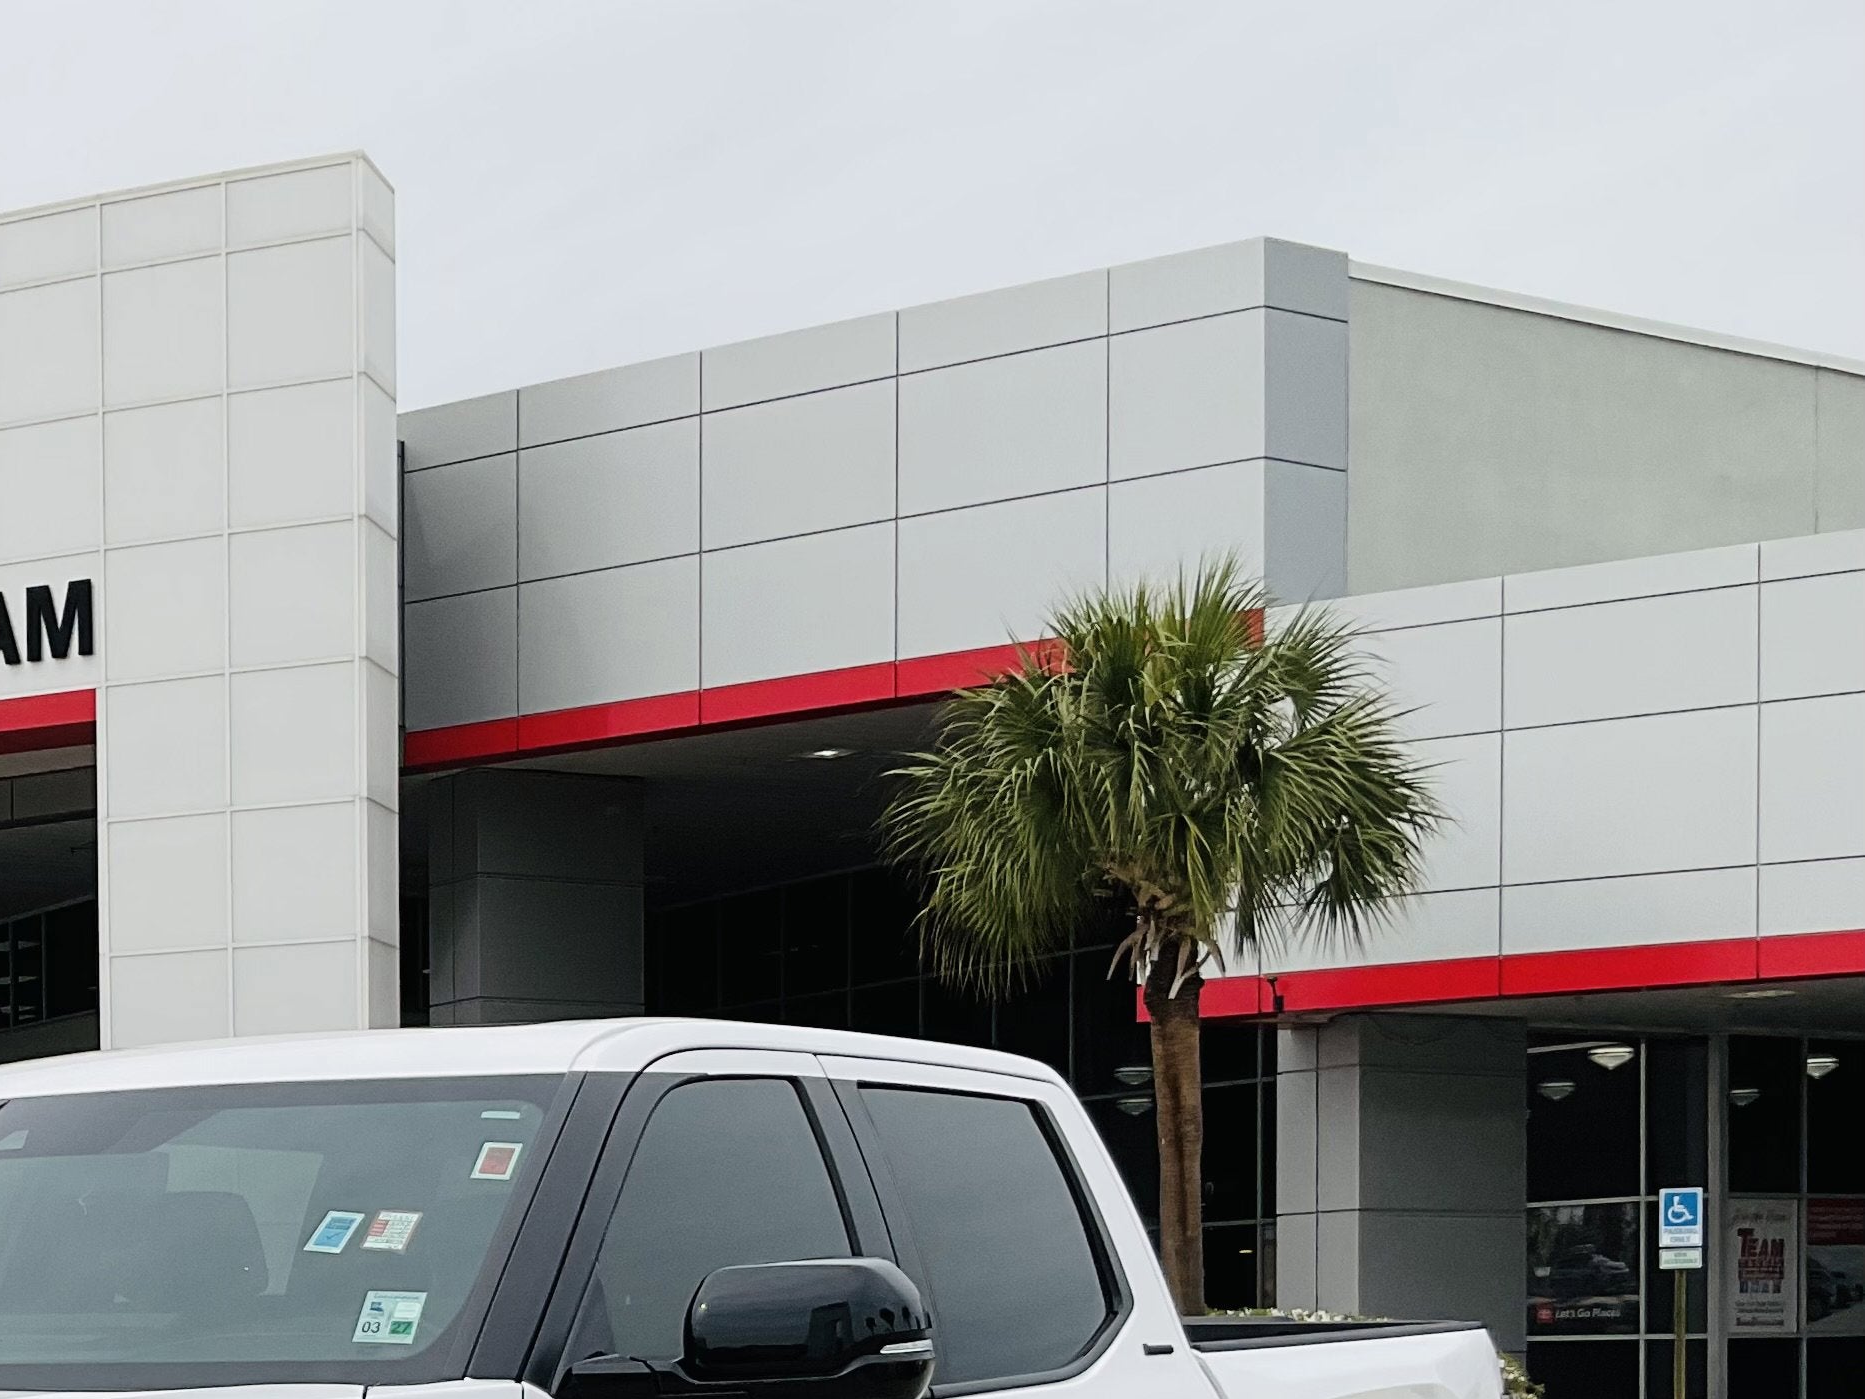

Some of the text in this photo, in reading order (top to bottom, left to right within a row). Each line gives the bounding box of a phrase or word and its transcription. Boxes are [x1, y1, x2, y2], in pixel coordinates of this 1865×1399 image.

[1737, 1228, 1785, 1258] TEAM
[1577, 1308, 1591, 1318] Go
[361, 1320, 413, 1335] 03 27
